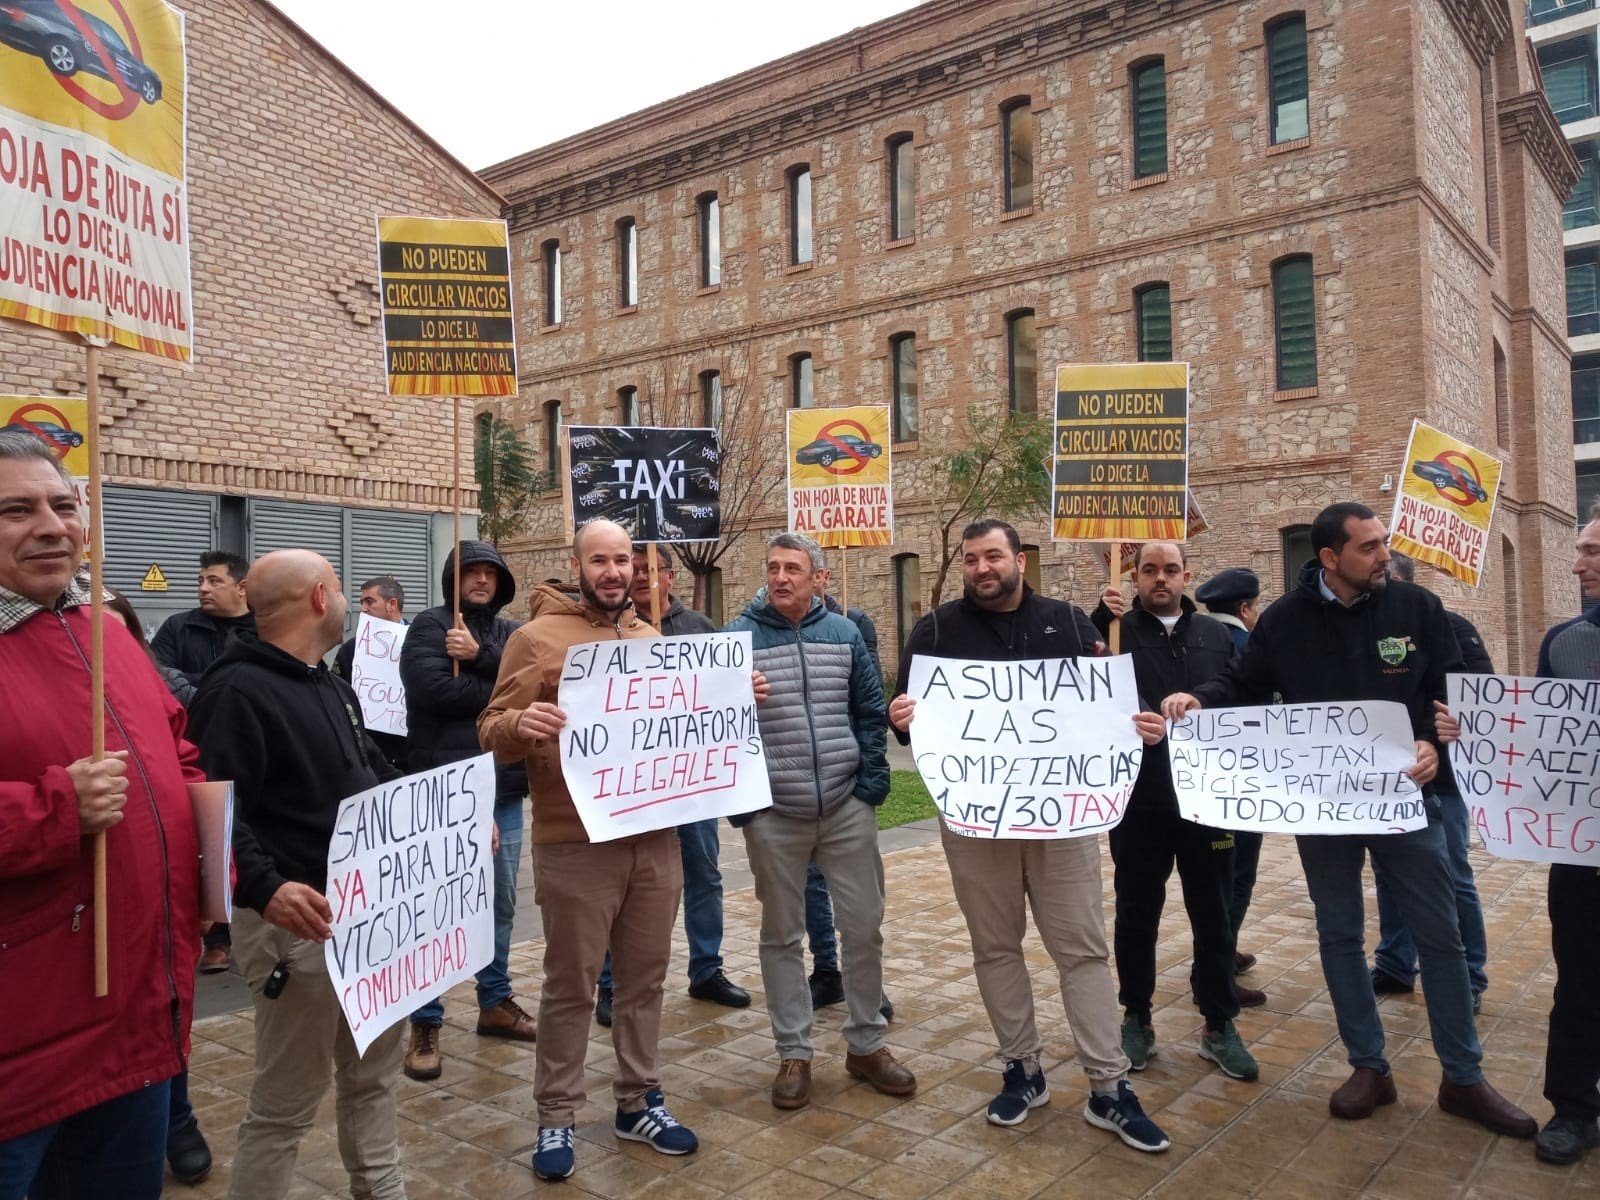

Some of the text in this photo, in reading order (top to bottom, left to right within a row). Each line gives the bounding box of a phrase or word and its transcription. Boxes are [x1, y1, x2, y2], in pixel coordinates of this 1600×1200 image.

[61, 148, 100, 210] DE
[105, 163, 157, 236] RUTA
[162, 185, 181, 245] SÍ
[42, 204, 132, 268] LO DICE LA
[402, 247, 487, 272] NO PUEDEN
[104, 264, 186, 331] NACIONAL
[386, 283, 507, 310] CIRCULAR VACIOS
[421, 321, 479, 339] LO DICE LA
[391, 351, 512, 372] AUDIENCIA NACIONAL
[1078, 393, 1163, 415] NO PUEDEN
[1059, 429, 1182, 452] CIRCULAR VACIOS
[611, 459, 685, 499] TAXI
[1090, 464, 1149, 483] LO DICE LA
[793, 486, 887, 508] SIN HOJA DE RUTA
[1058, 495, 1119, 515] AUDIENCIA
[1122, 495, 1181, 516] NACIONAL
[794, 507, 886, 531] AL GARAJE
[1401, 496, 1482, 549] SIN HOJA DE RUTA
[1397, 515, 1480, 568] AL GARAJE
[359, 620, 401, 662] ASU
[605, 645, 638, 675] AL
[604, 674, 710, 713] LEGAL
[922, 658, 1113, 703] ASUMAN
[569, 724, 609, 758] NO
[961, 708, 1058, 744] LAS
[592, 746, 739, 800] ILEGALES
[332, 764, 476, 864] SANCIONES
[1215, 796, 1305, 823] TODO
[379, 840, 436, 903] PARA
[444, 822, 478, 878] LAS
[434, 866, 488, 929] OTRA
